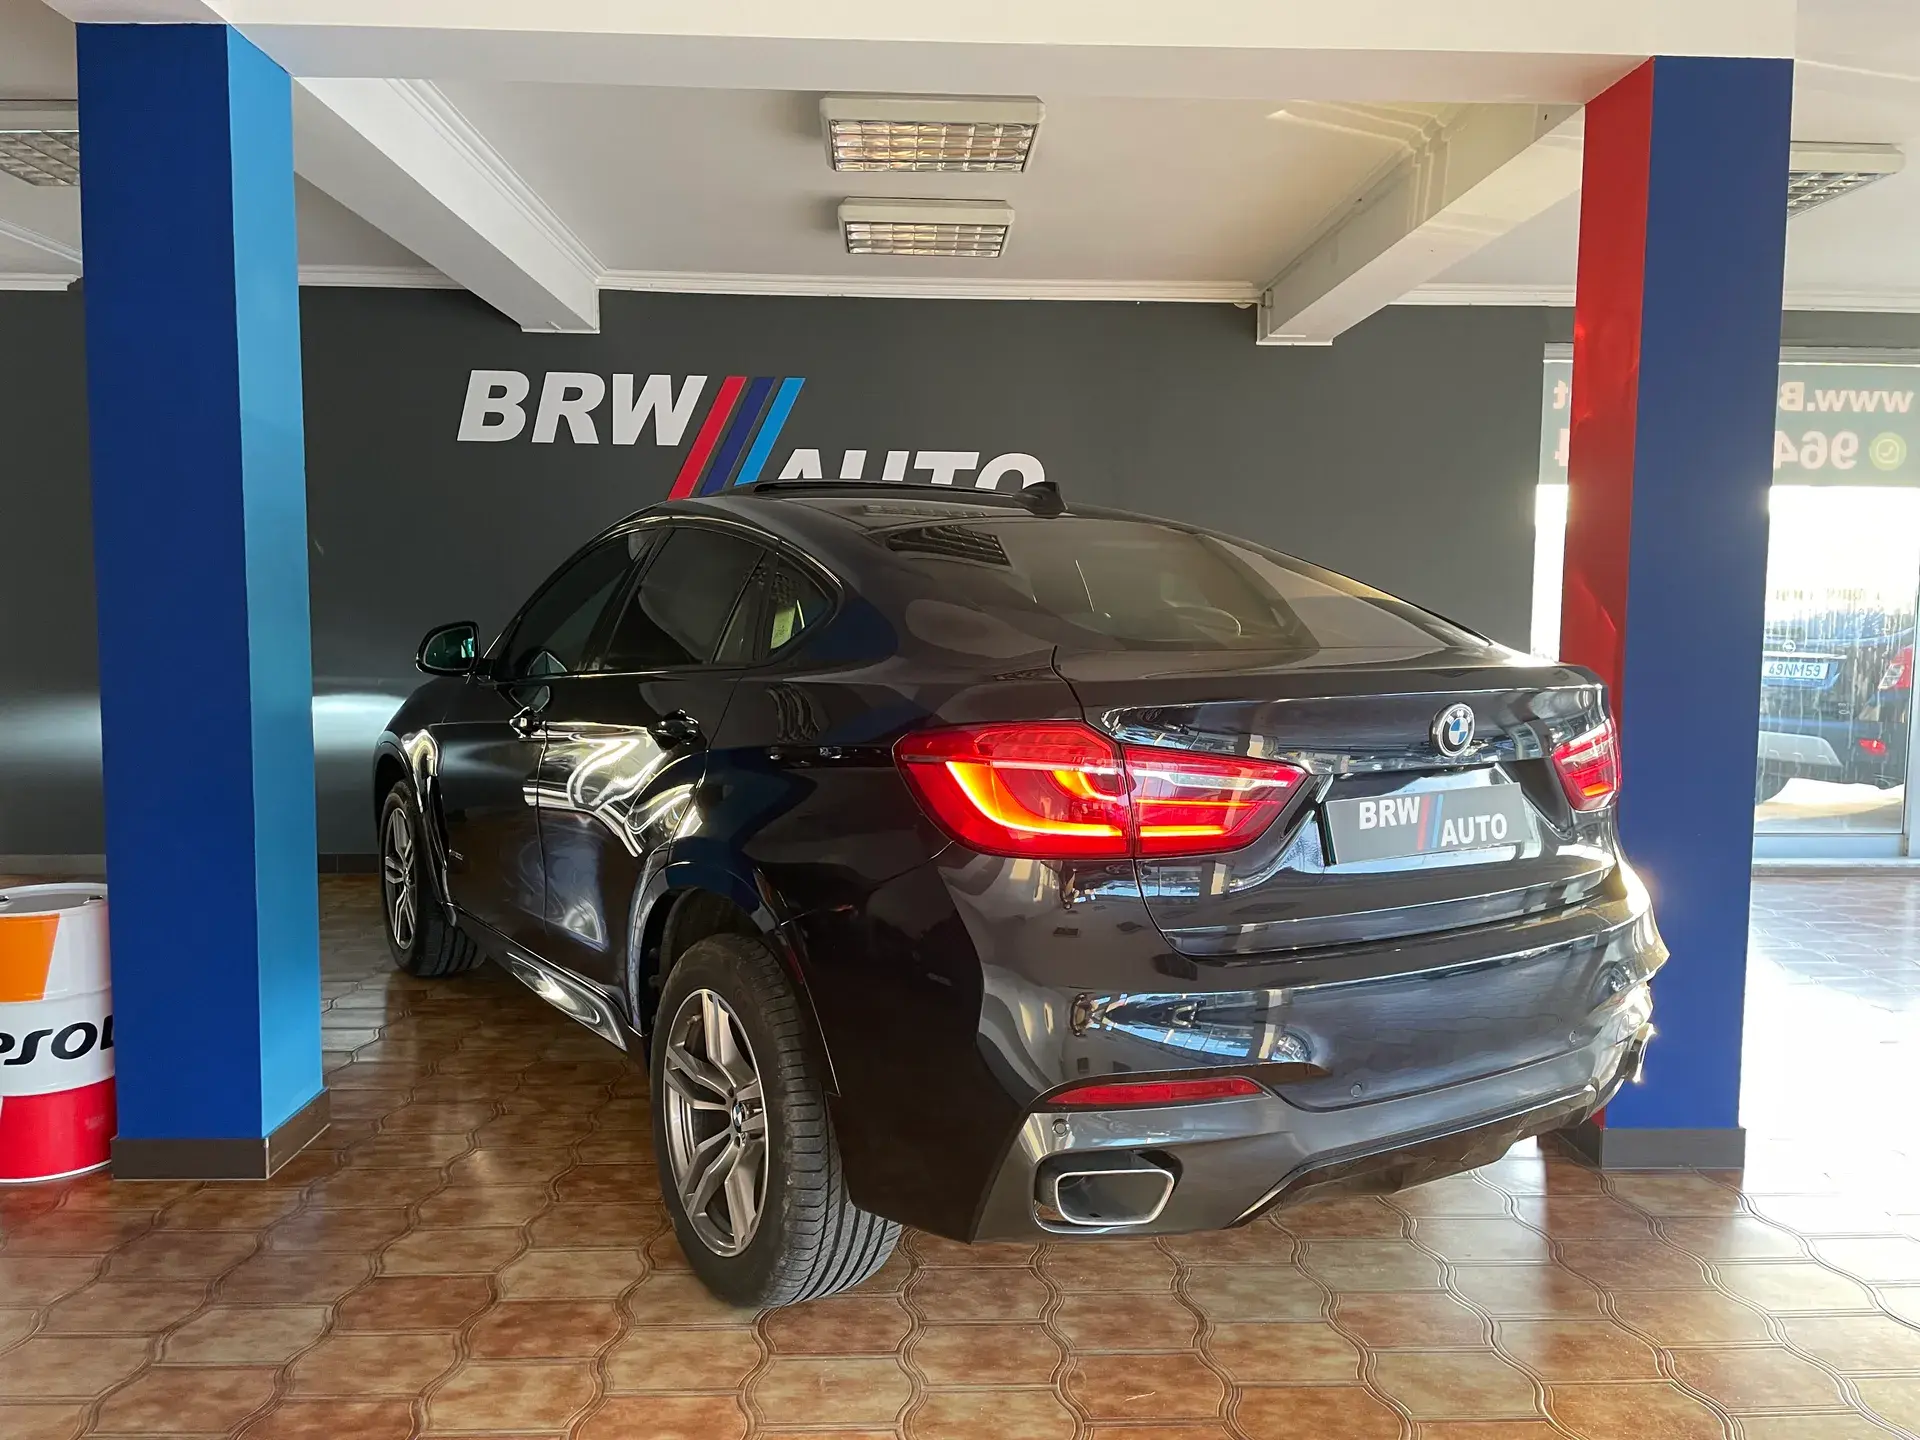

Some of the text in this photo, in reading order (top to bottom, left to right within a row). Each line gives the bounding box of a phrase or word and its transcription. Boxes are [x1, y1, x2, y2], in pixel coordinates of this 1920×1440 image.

[457, 369, 708, 446] BRW
[1359, 796, 1420, 830] BRW
[1441, 812, 1508, 847] AUTO
